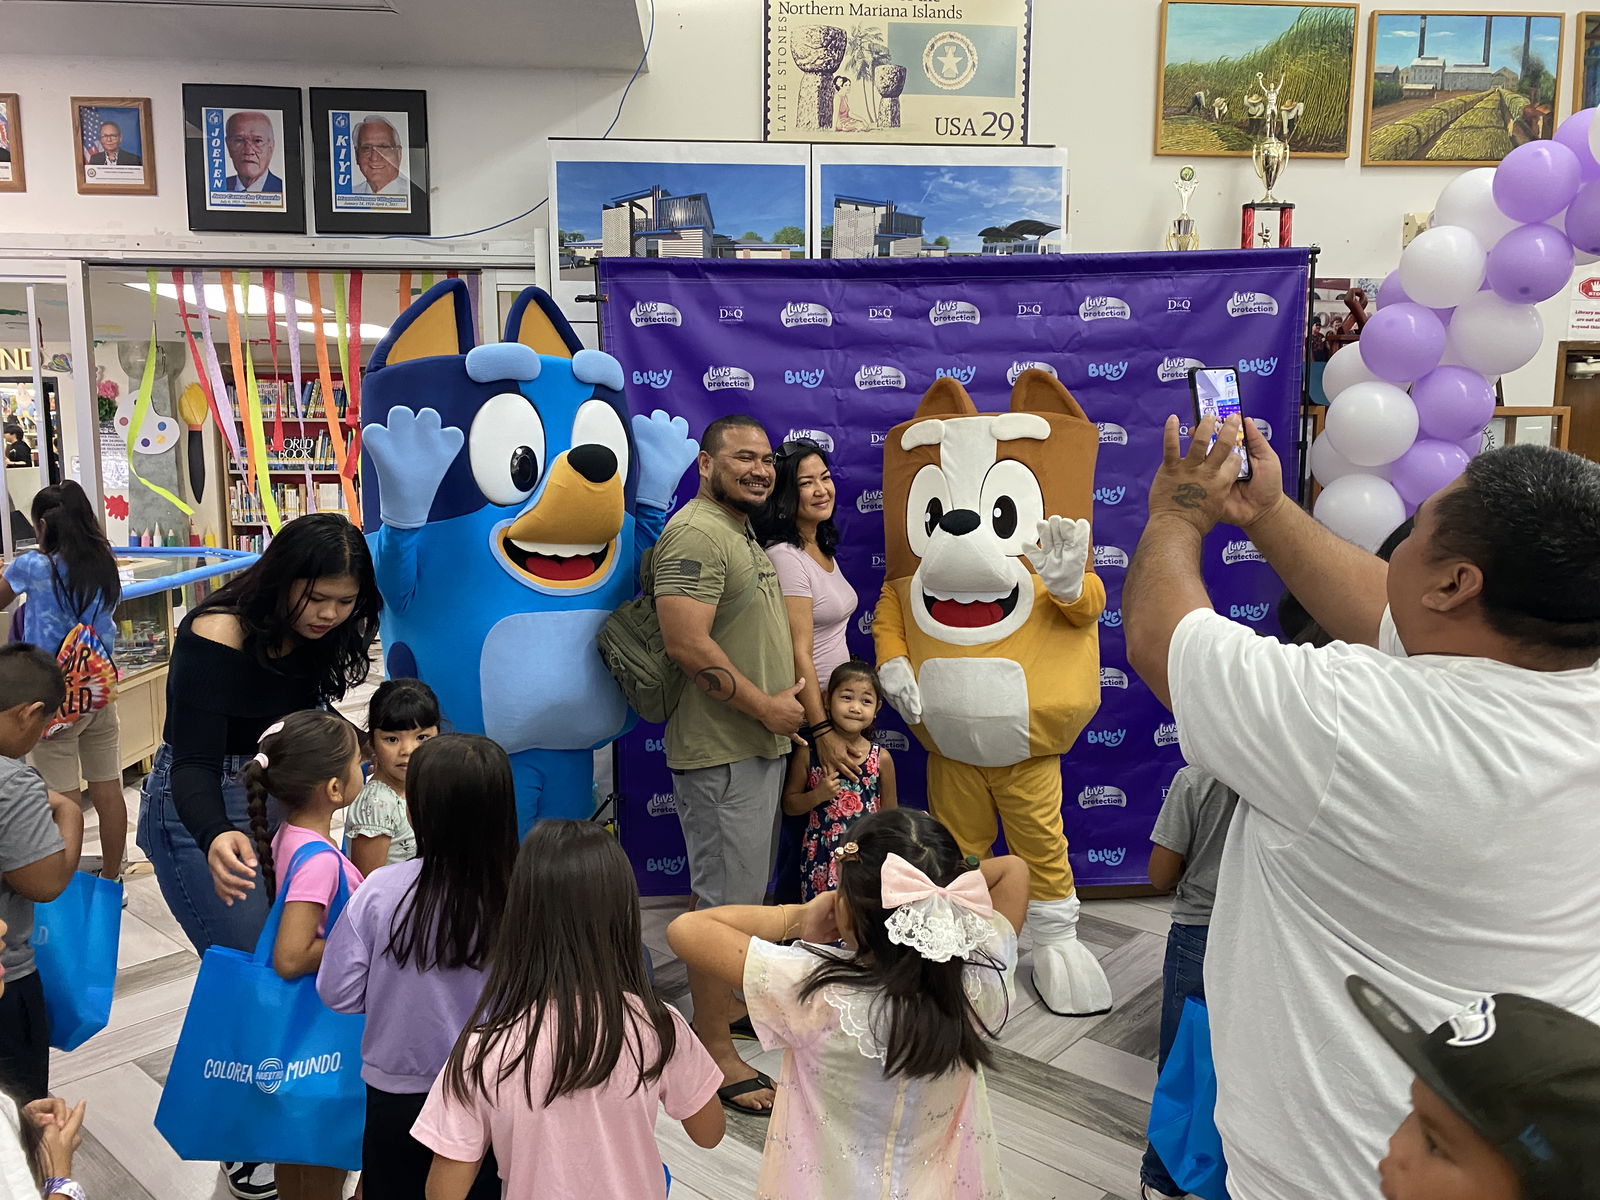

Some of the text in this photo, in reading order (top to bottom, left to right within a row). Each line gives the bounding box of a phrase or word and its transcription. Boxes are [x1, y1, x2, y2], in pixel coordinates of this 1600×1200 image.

[778, 1, 963, 19] Northern Mariana Islands
[778, 16, 787, 132] LATTE STONES
[935, 112, 1015, 140] USA 29
[211, 128, 223, 188] JOETEN
[336, 135, 350, 185] KIYU
[1086, 296, 1107, 309] Luvs
[1168, 300, 1191, 309] D&Q
[1233, 291, 1255, 305] Luvs
[636, 301, 657, 315] Luvs
[720, 309, 743, 319] D&Q
[787, 301, 808, 315] Luvs
[869, 309, 892, 318] D&Q
[935, 300, 957, 314] Luvs
[1018, 305, 1042, 315] D&Q
[1083, 310, 1126, 318] protection
[1231, 305, 1274, 314] protection
[785, 316, 828, 324] protection
[1163, 357, 1185, 371] Luvs
[1239, 357, 1278, 377] BLUEY
[632, 369, 672, 388] BLUEY
[709, 367, 730, 380] Luvs
[784, 369, 824, 388] BLUEY
[861, 365, 882, 379] Luvs
[1088, 362, 1128, 381] BLUEY
[708, 380, 750, 388] protection
[859, 379, 901, 387] protection
[1230, 603, 1270, 621] BLUEY
[1087, 729, 1126, 747] BLUEY
[653, 793, 674, 806] Luvs
[1085, 786, 1104, 799] Luvs
[1088, 848, 1126, 866] BLUEY
[647, 856, 686, 875] BLUEY
[203, 1051, 341, 1084] COLOREA NUESTRO MUNDO
